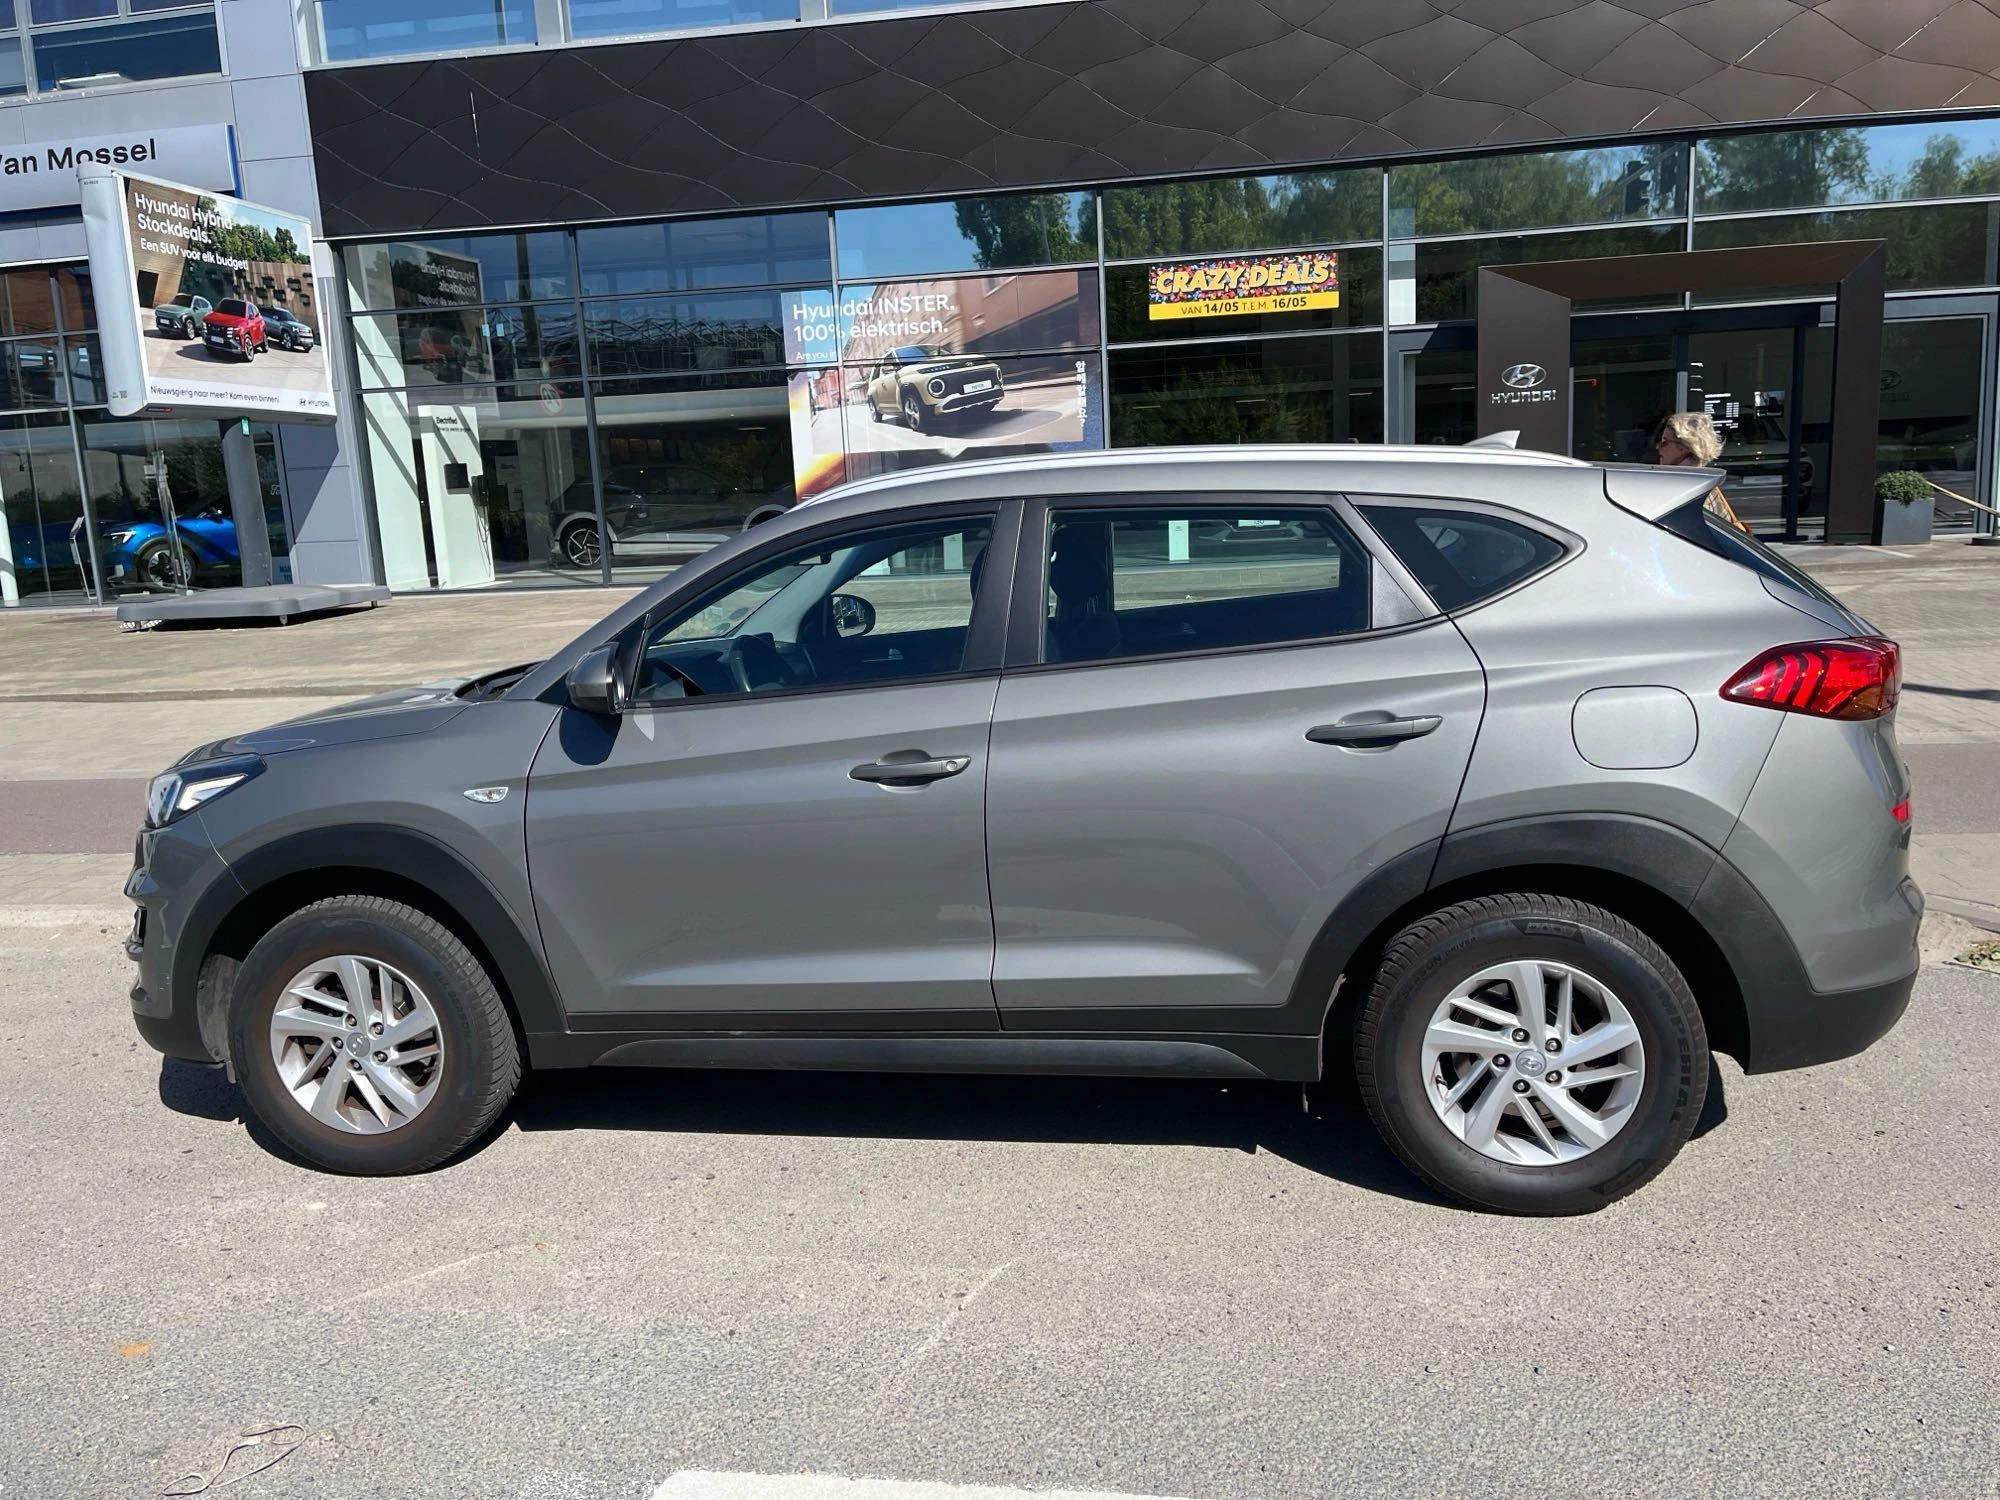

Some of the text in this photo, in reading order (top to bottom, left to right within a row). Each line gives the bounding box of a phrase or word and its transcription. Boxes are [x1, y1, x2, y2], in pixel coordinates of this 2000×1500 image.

[47, 138, 156, 171] Mossel
[134, 192, 233, 230] Hyundai Hybrid
[137, 213, 212, 244] Stockdeals.
[140, 237, 249, 271] Een SUV voor elk budget!
[1156, 261, 1330, 294] CRAZY DEALS
[793, 294, 955, 322] Hyundai INSTER.
[1181, 297, 1307, 315] VAN 14/05 T.E.M. 16/05
[794, 317, 949, 342] 100% elektrisch.
[796, 351, 810, 361] Are
[811, 351, 828, 361] you
[150, 385, 193, 398] Nieuwsgierig
[194, 389, 208, 398] naar
[209, 391, 229, 399] meer?
[229, 391, 243, 400] Kom
[1491, 389, 1557, 404] HYUNDAI
